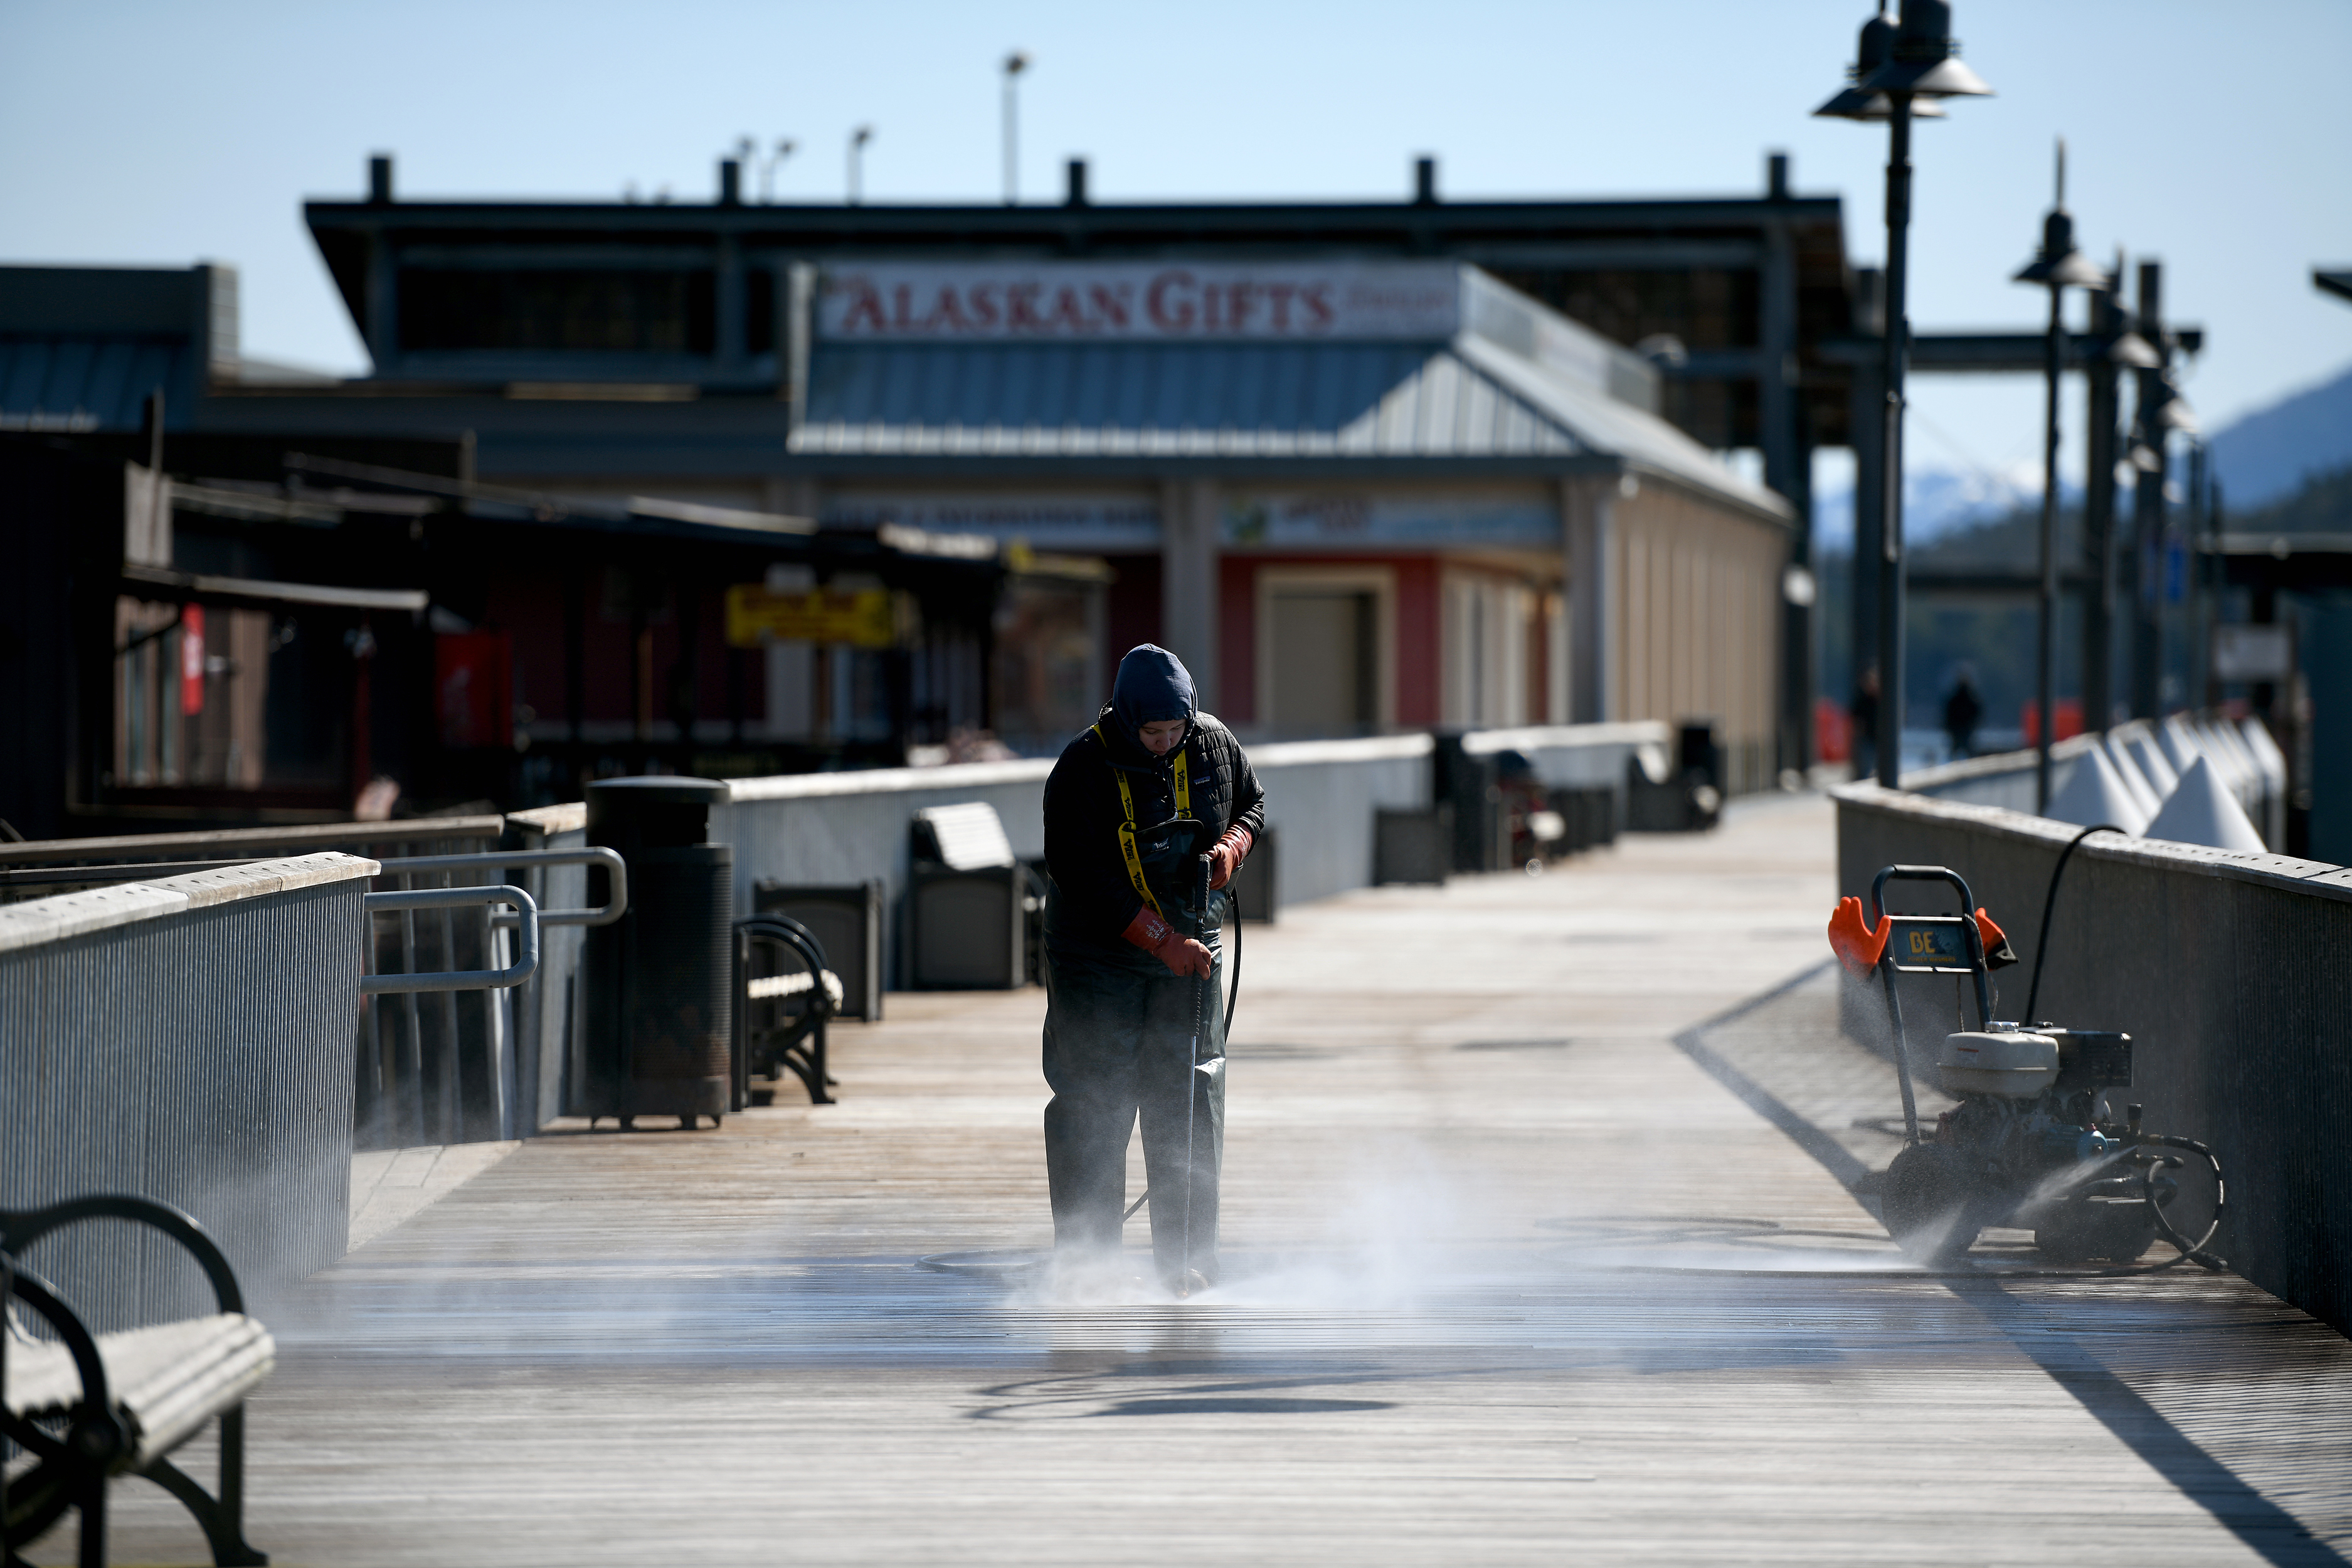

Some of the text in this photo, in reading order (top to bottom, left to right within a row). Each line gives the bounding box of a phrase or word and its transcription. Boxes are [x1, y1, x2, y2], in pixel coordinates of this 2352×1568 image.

[840, 270, 1336, 332] ALASKAN GIFTS
[1123, 838, 1135, 861] VIKING
[1909, 931, 1936, 954] BE
